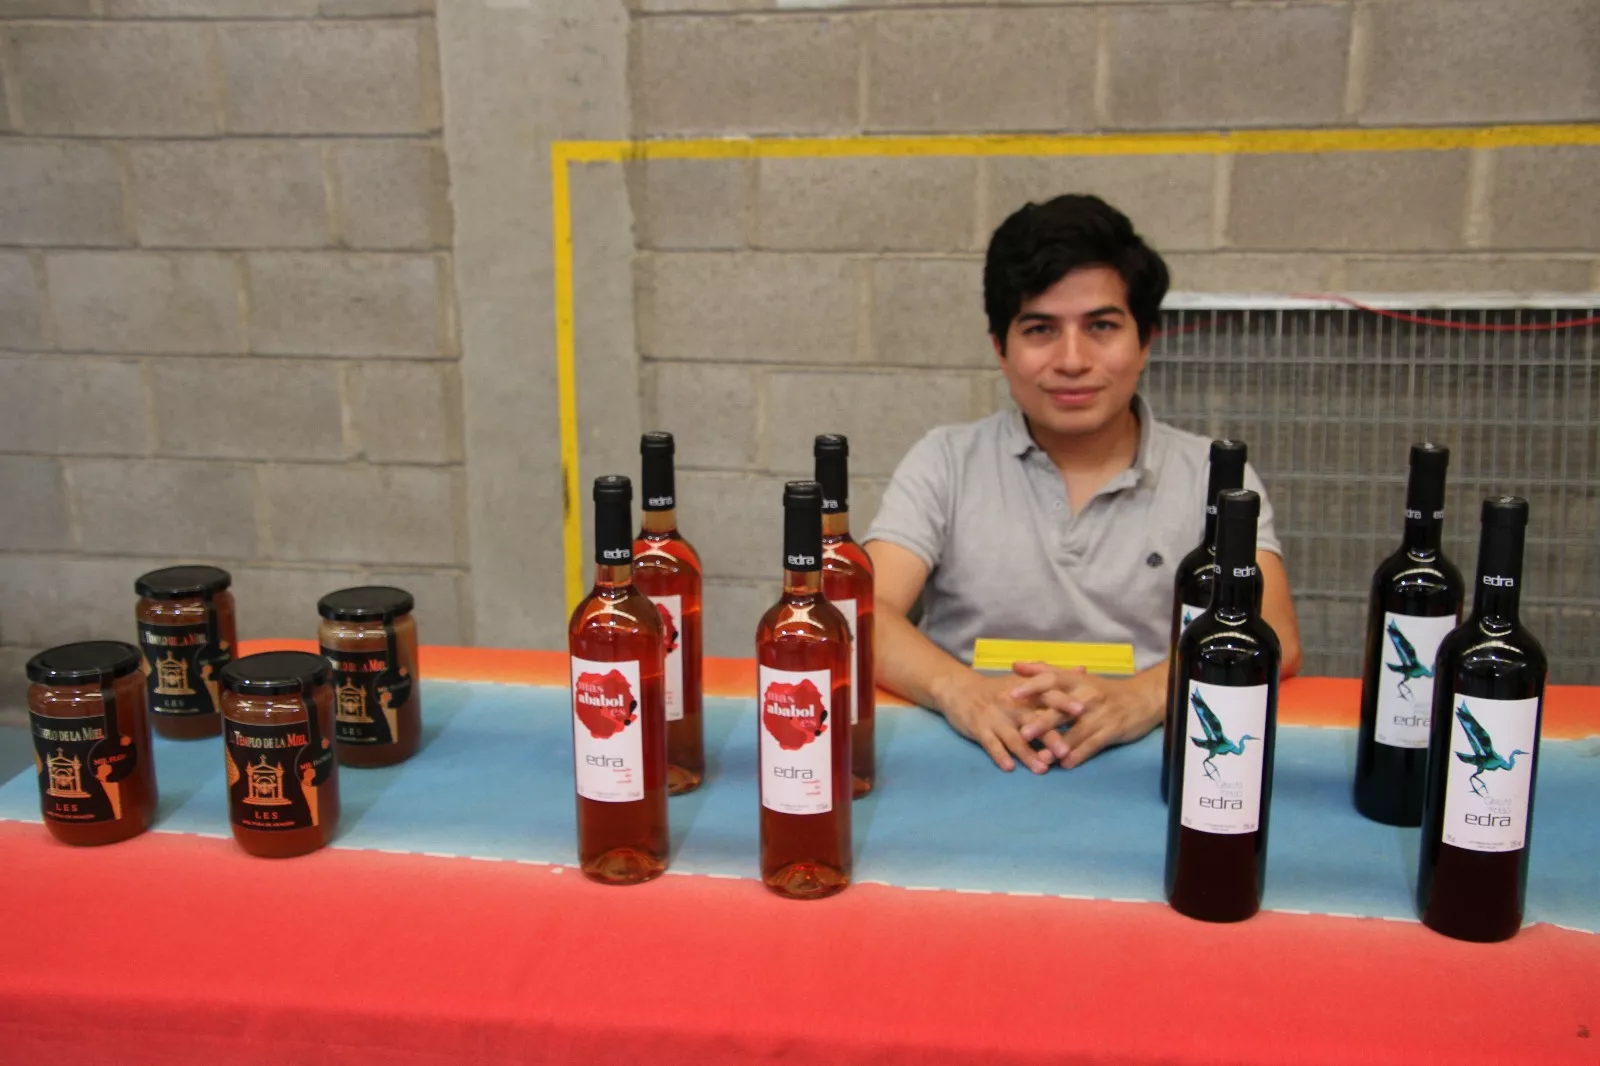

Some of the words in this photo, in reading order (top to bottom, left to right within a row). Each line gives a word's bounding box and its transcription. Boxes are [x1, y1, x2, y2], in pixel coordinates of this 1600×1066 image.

[648, 496, 673, 507] edra
[603, 548, 631, 559] edra
[787, 553, 815, 566] edra
[1483, 575, 1514, 587] edra
[578, 692, 624, 707] ababol
[767, 702, 815, 717] ababol
[586, 754, 624, 768] edra
[773, 766, 813, 780] edra
[1199, 796, 1243, 810] edra
[255, 811, 279, 820] LES
[1464, 813, 1511, 827] edra
